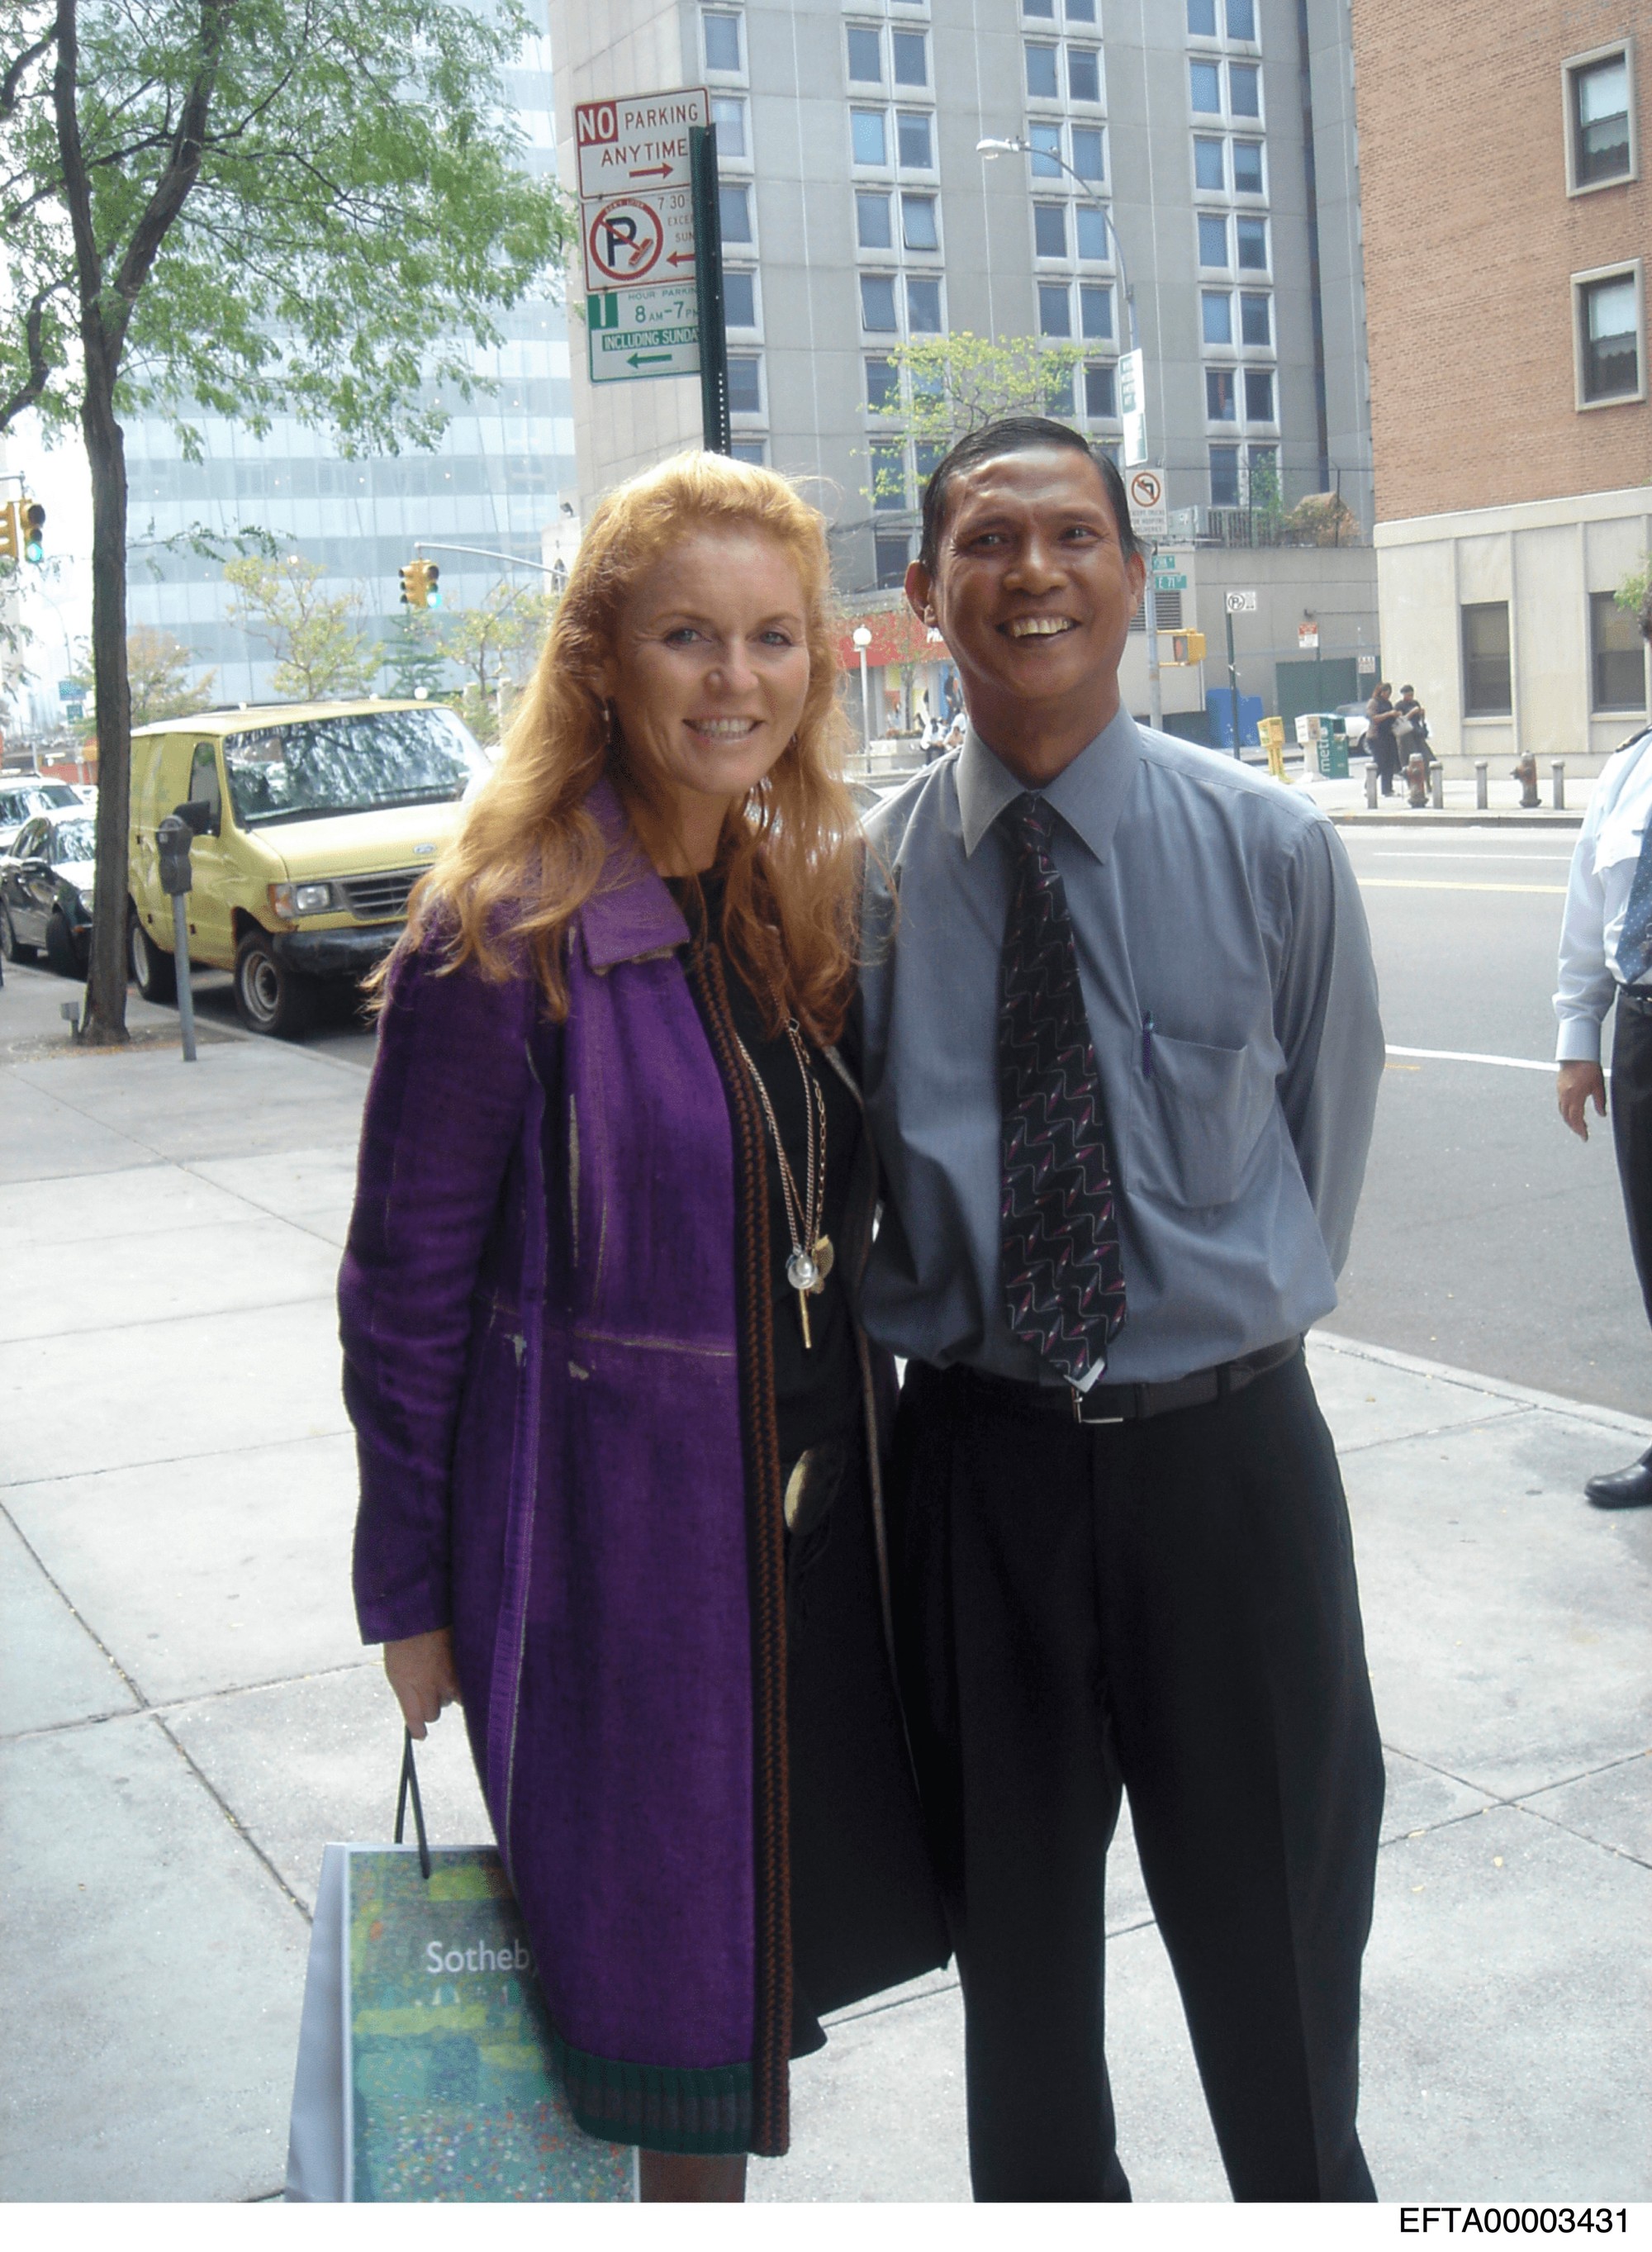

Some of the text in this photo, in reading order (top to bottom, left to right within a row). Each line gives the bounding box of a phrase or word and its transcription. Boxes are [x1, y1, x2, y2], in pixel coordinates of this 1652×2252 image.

[578, 103, 699, 142] NO PARKING
[601, 138, 689, 168] ANYTIME
[667, 215, 693, 226] EXCE
[675, 231, 694, 243] SUN
[629, 291, 656, 301] HOUR
[662, 287, 697, 297] PARKIN
[605, 328, 698, 350] INCLUDING SUNDA
[426, 1939, 530, 1974] Sotheb
